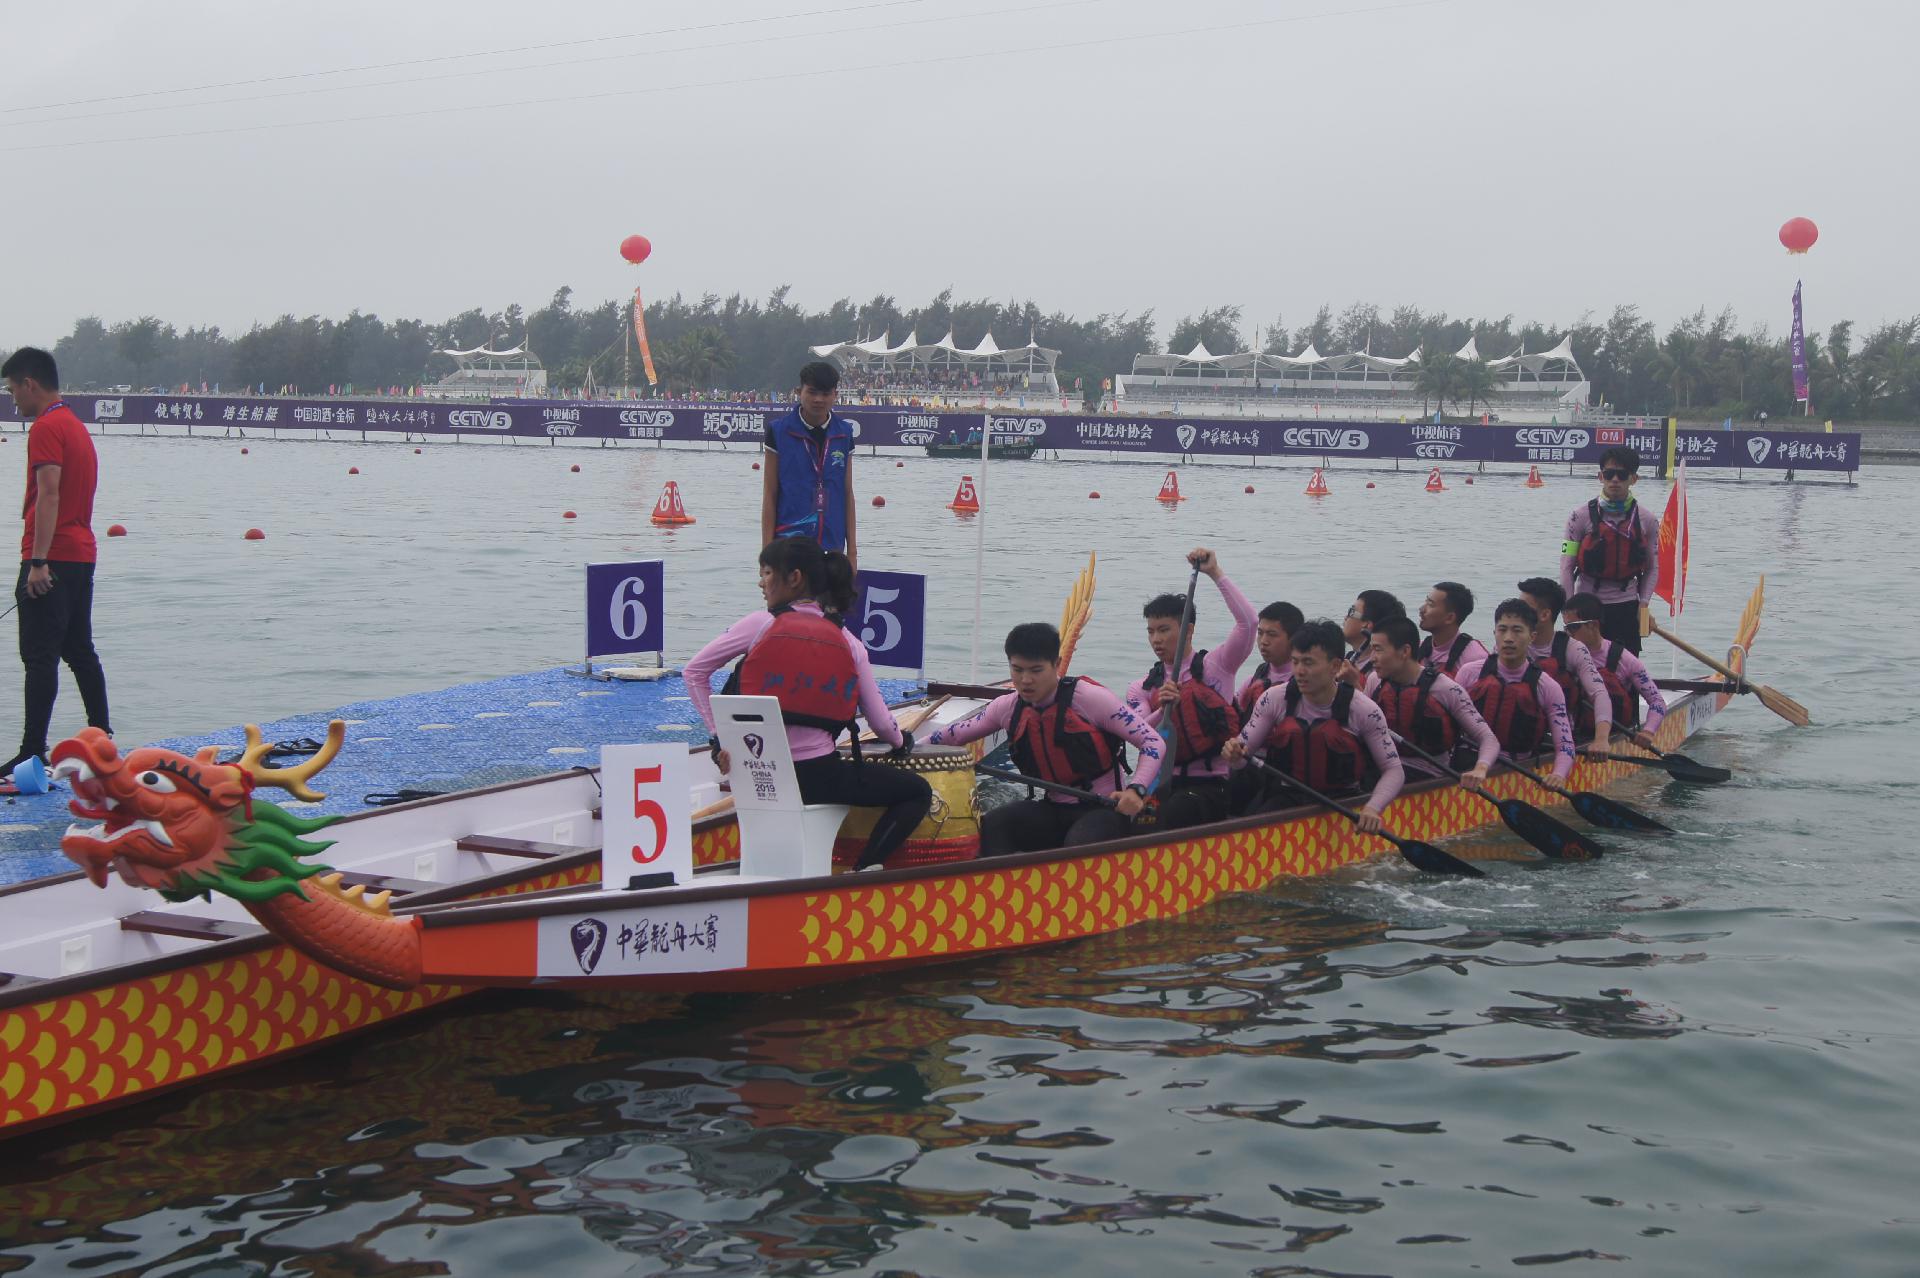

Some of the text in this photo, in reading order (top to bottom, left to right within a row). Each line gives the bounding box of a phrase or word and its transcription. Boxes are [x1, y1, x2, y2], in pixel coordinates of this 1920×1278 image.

[448, 410, 512, 430] CCTV5
[543, 408, 580, 421] 中视体育
[897, 415, 940, 429] 中视体育
[546, 424, 577, 436] CCTV
[703, 412, 766, 439] 第5频道
[1076, 422, 1154, 439] 中国龙舟协会
[1411, 425, 1461, 440] 中视体育
[900, 433, 935, 445] CCTV
[1283, 427, 1370, 450] CCTV5
[1515, 429, 1590, 448] CCTV5+
[1415, 445, 1456, 458] CCTV
[1528, 448, 1575, 461] 体育赛事
[1164, 474, 1174, 493] 4
[1310, 472, 1318, 488] 3
[1430, 470, 1440, 485] 2
[660, 486, 672, 512] 6
[961, 480, 974, 501] 5
[609, 576, 648, 641] 6
[860, 586, 902, 651] 5
[754, 783, 776, 793] 2019
[631, 763, 668, 864] 5
